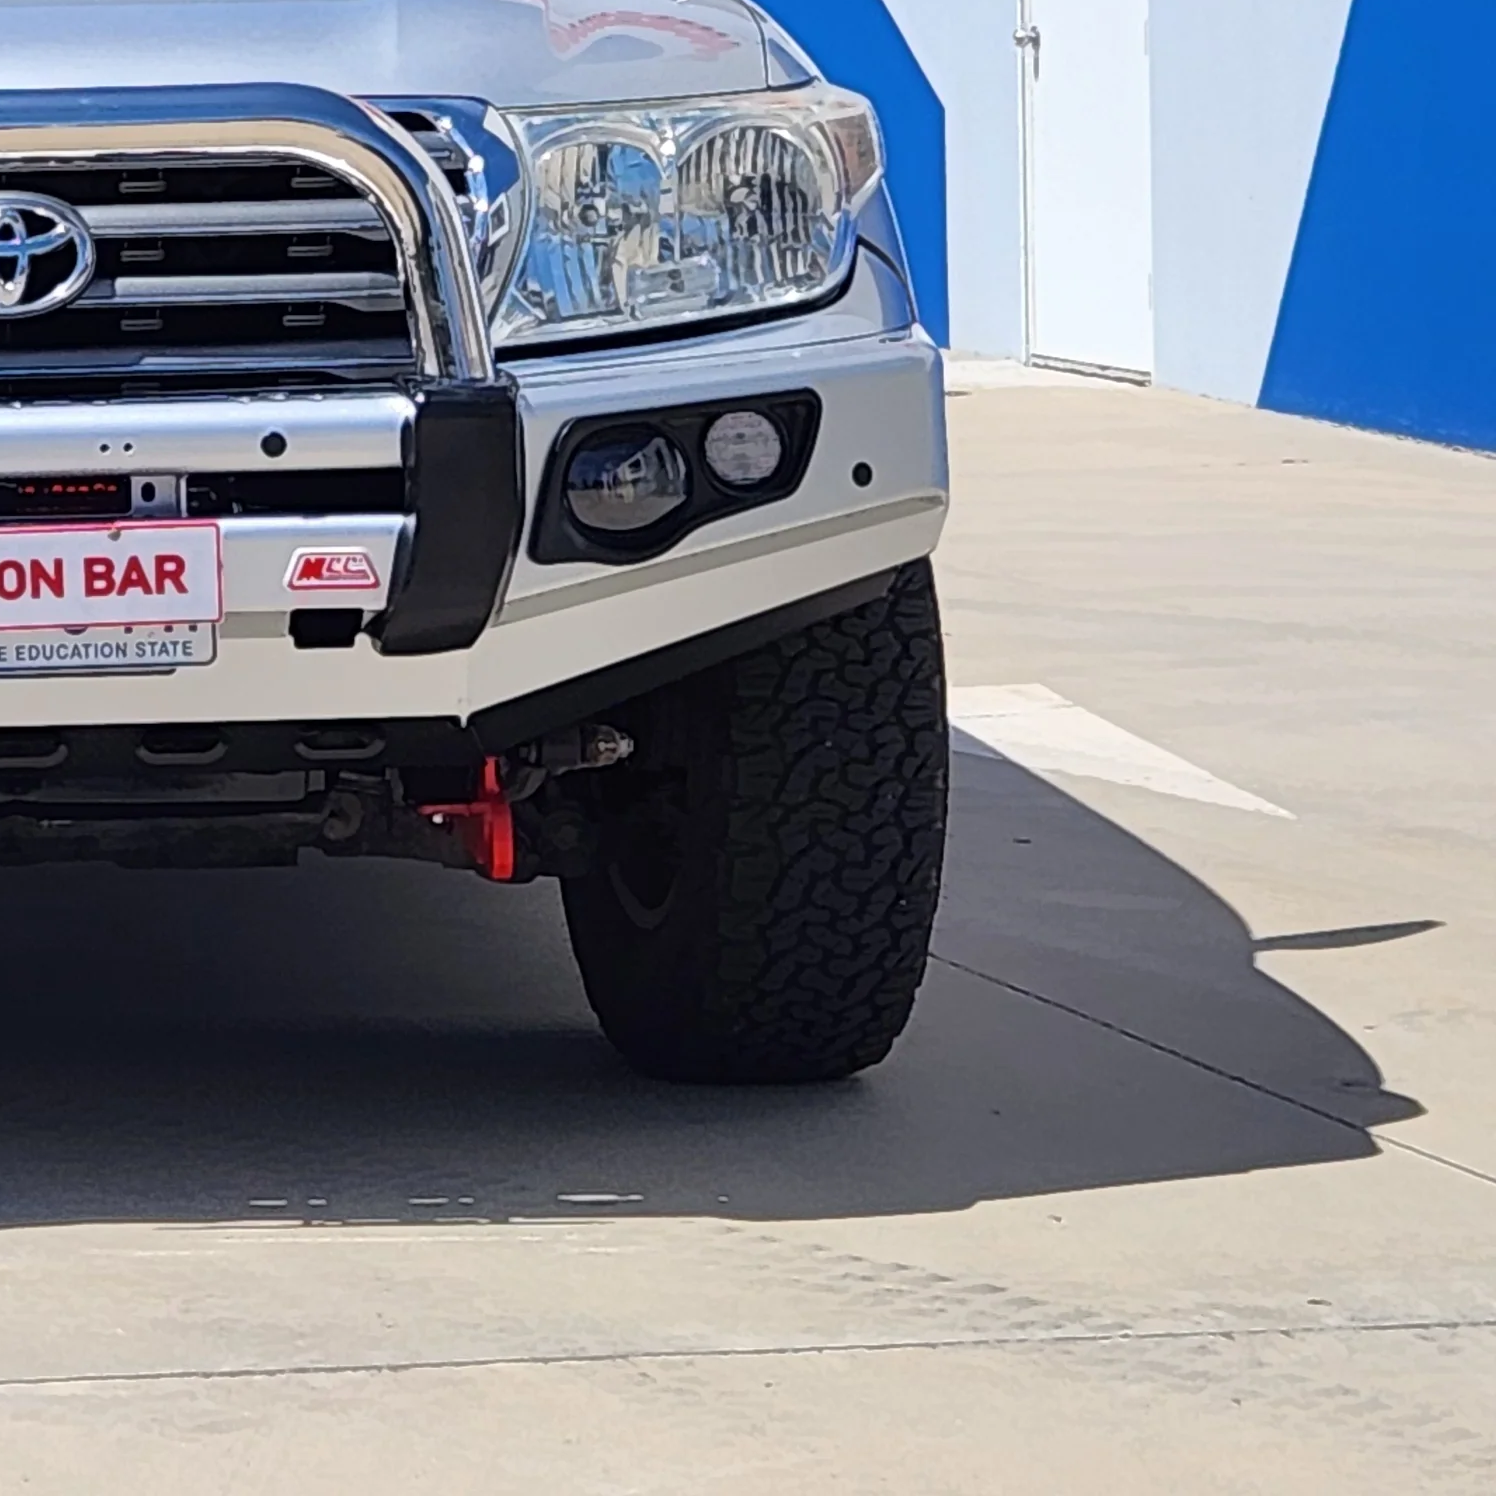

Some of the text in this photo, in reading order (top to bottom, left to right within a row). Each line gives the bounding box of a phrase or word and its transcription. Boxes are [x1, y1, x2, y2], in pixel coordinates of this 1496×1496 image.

[84, 554, 188, 596] BAR
[15, 641, 128, 663] EDUCATION
[134, 638, 194, 659] STATE
